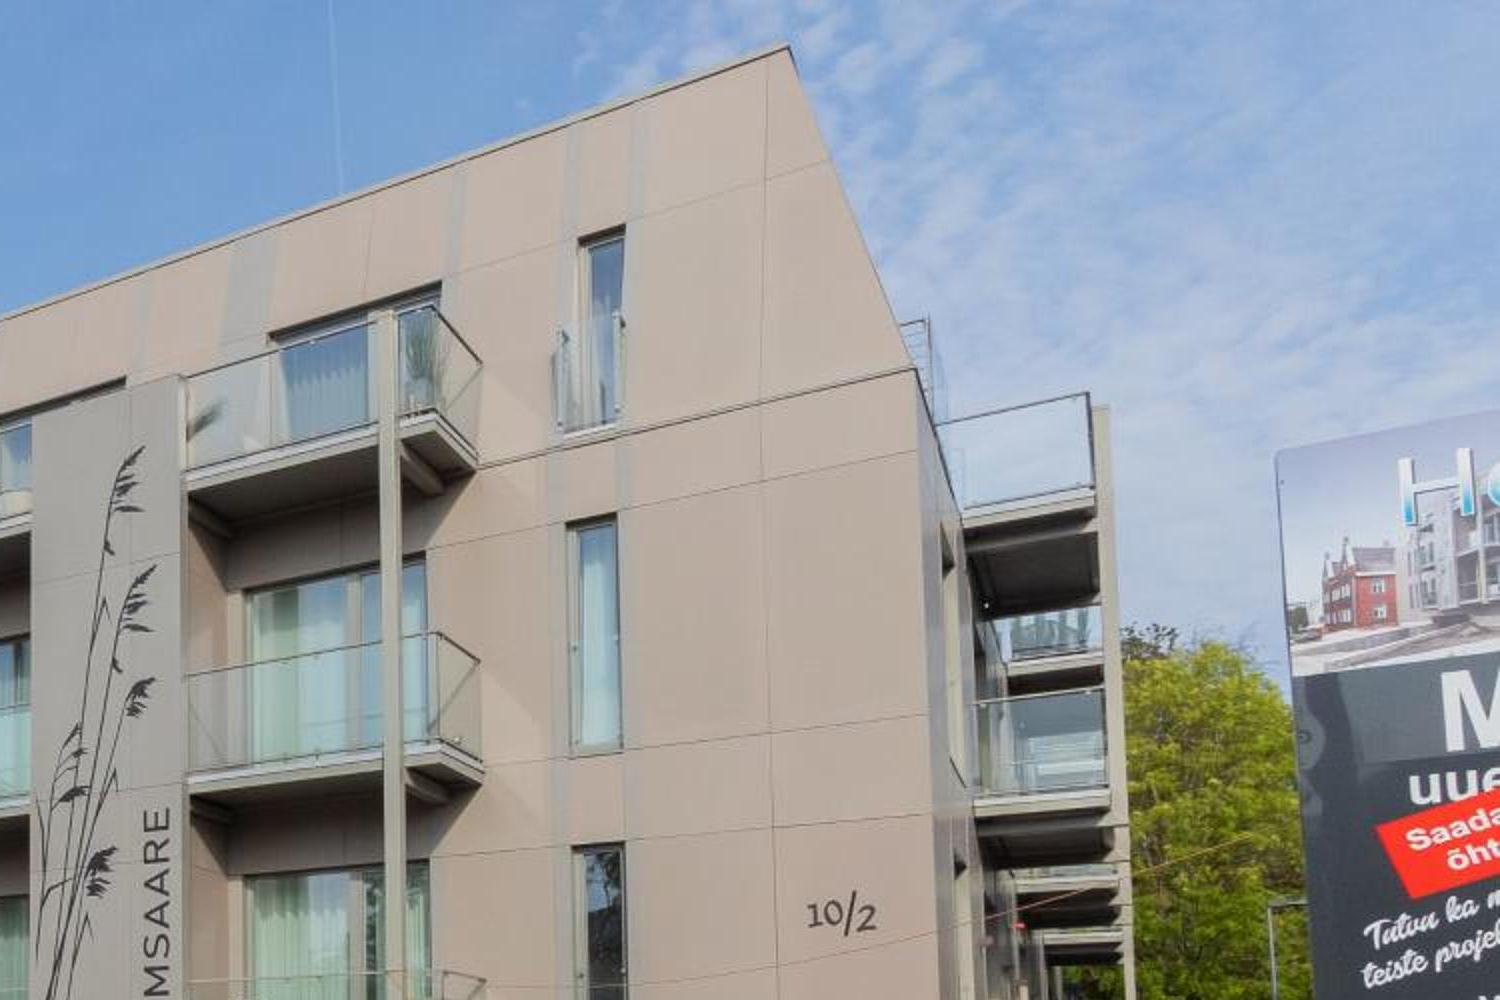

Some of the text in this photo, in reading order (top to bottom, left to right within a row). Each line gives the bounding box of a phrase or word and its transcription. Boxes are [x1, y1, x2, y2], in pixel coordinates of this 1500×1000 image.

[1397, 447, 1500, 528] H
[807, 889, 877, 937] 10/2
[1363, 912, 1440, 951] Tutvu
[1445, 895, 1480, 923] ka
[1359, 949, 1429, 989] teiste
